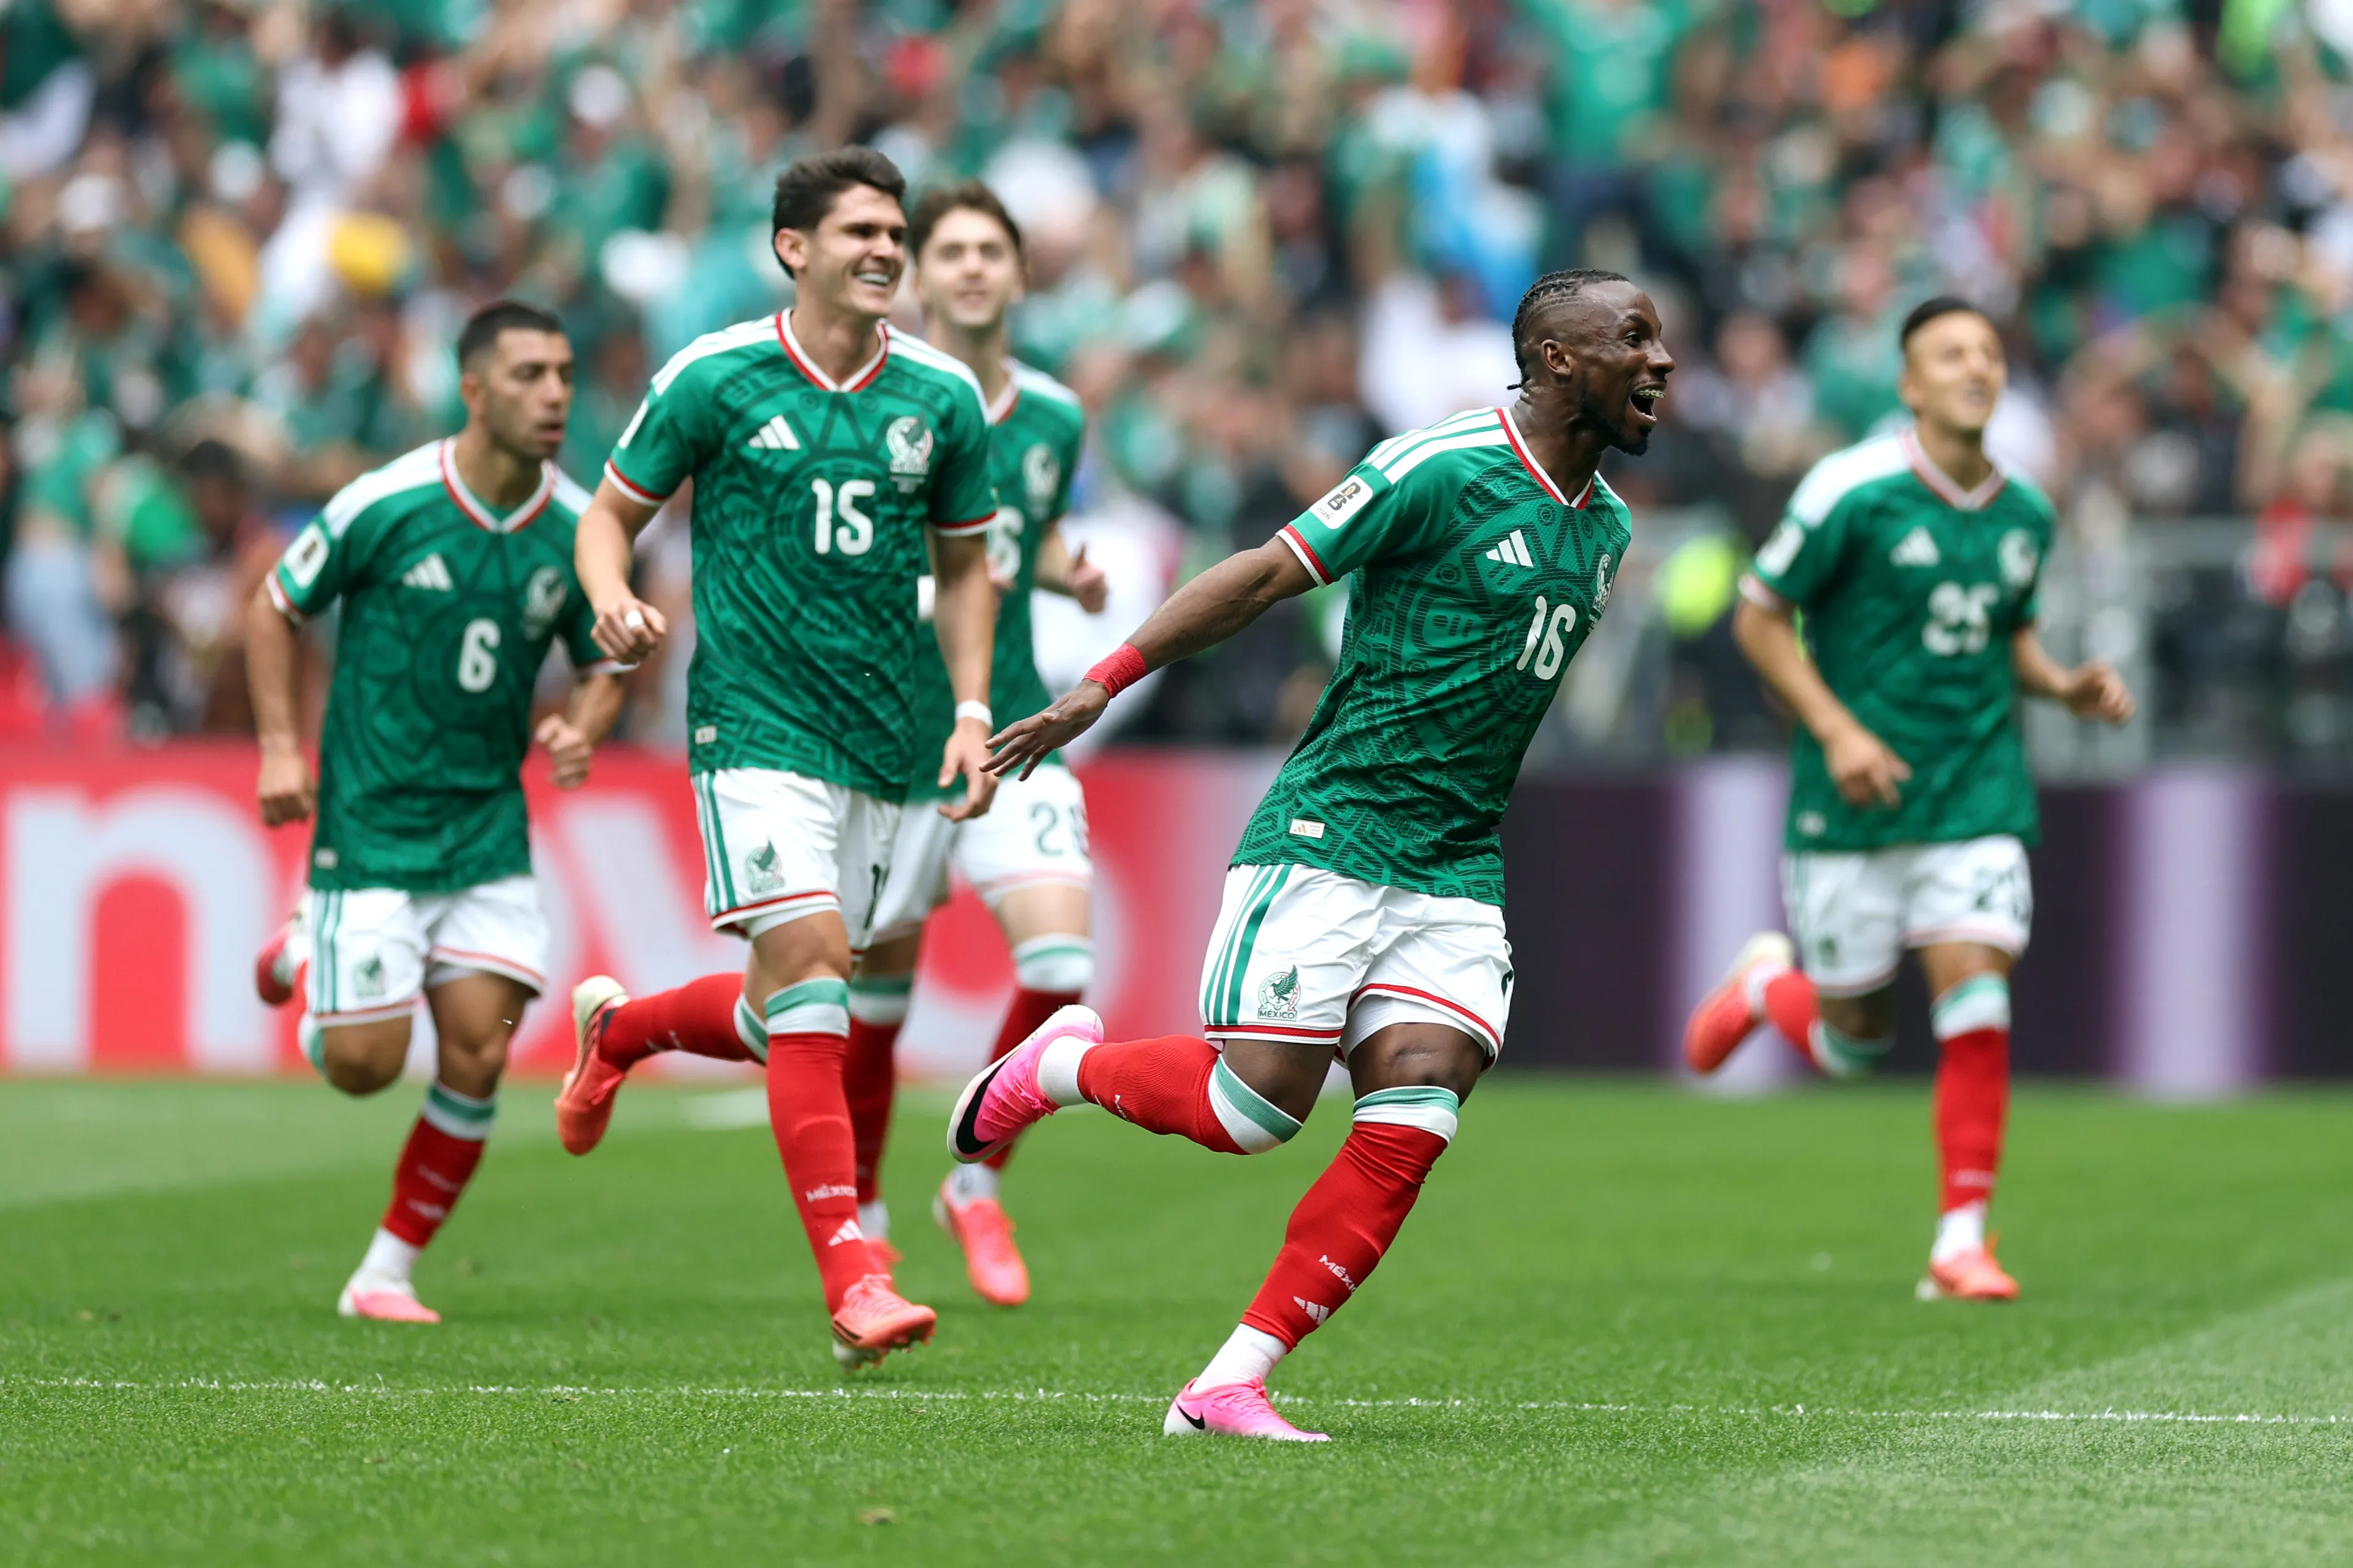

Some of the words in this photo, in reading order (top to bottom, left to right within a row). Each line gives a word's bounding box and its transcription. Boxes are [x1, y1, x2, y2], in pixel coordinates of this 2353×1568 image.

[811, 478, 875, 555] 15
[458, 617, 501, 693] 6
[1516, 595, 1576, 680] 16
[1922, 580, 1999, 656] 25
[1259, 1009, 1295, 1019] MÉXICO
